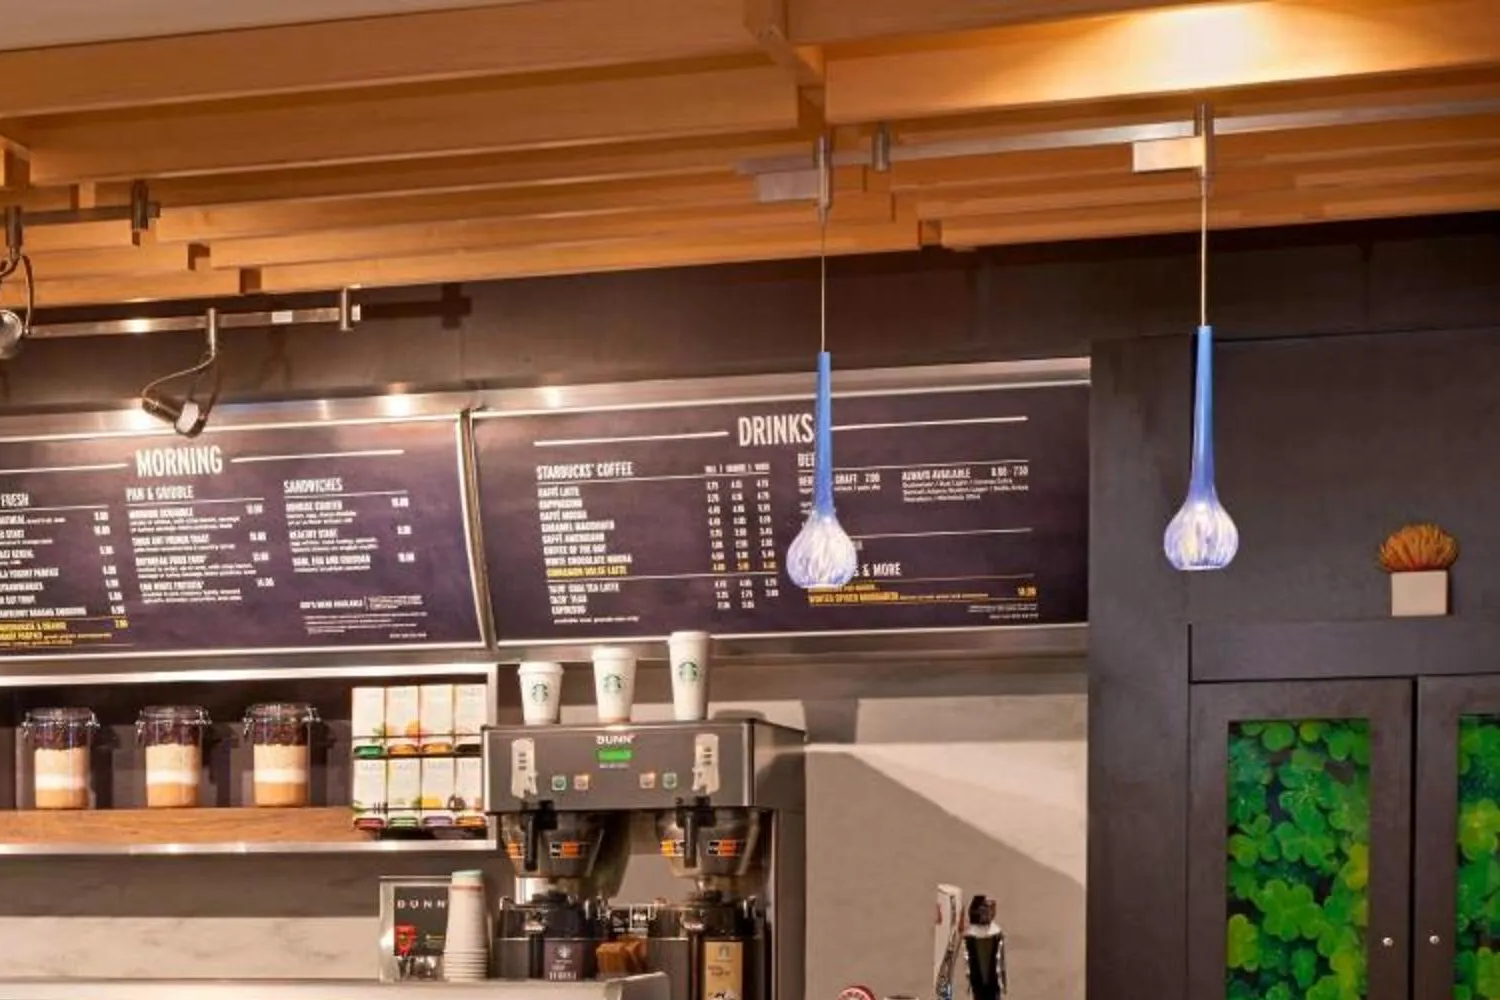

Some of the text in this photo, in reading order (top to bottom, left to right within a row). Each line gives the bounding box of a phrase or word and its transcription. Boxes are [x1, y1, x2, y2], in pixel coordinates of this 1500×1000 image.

[738, 413, 815, 447] DRINKS
[135, 445, 223, 478] MORNING
[597, 461, 634, 477] COFFEE
[283, 478, 343, 493] SANDWICHES
[0, 493, 30, 507] FRESH
[863, 562, 902, 577] & MORE
[596, 735, 633, 746] BUNN
